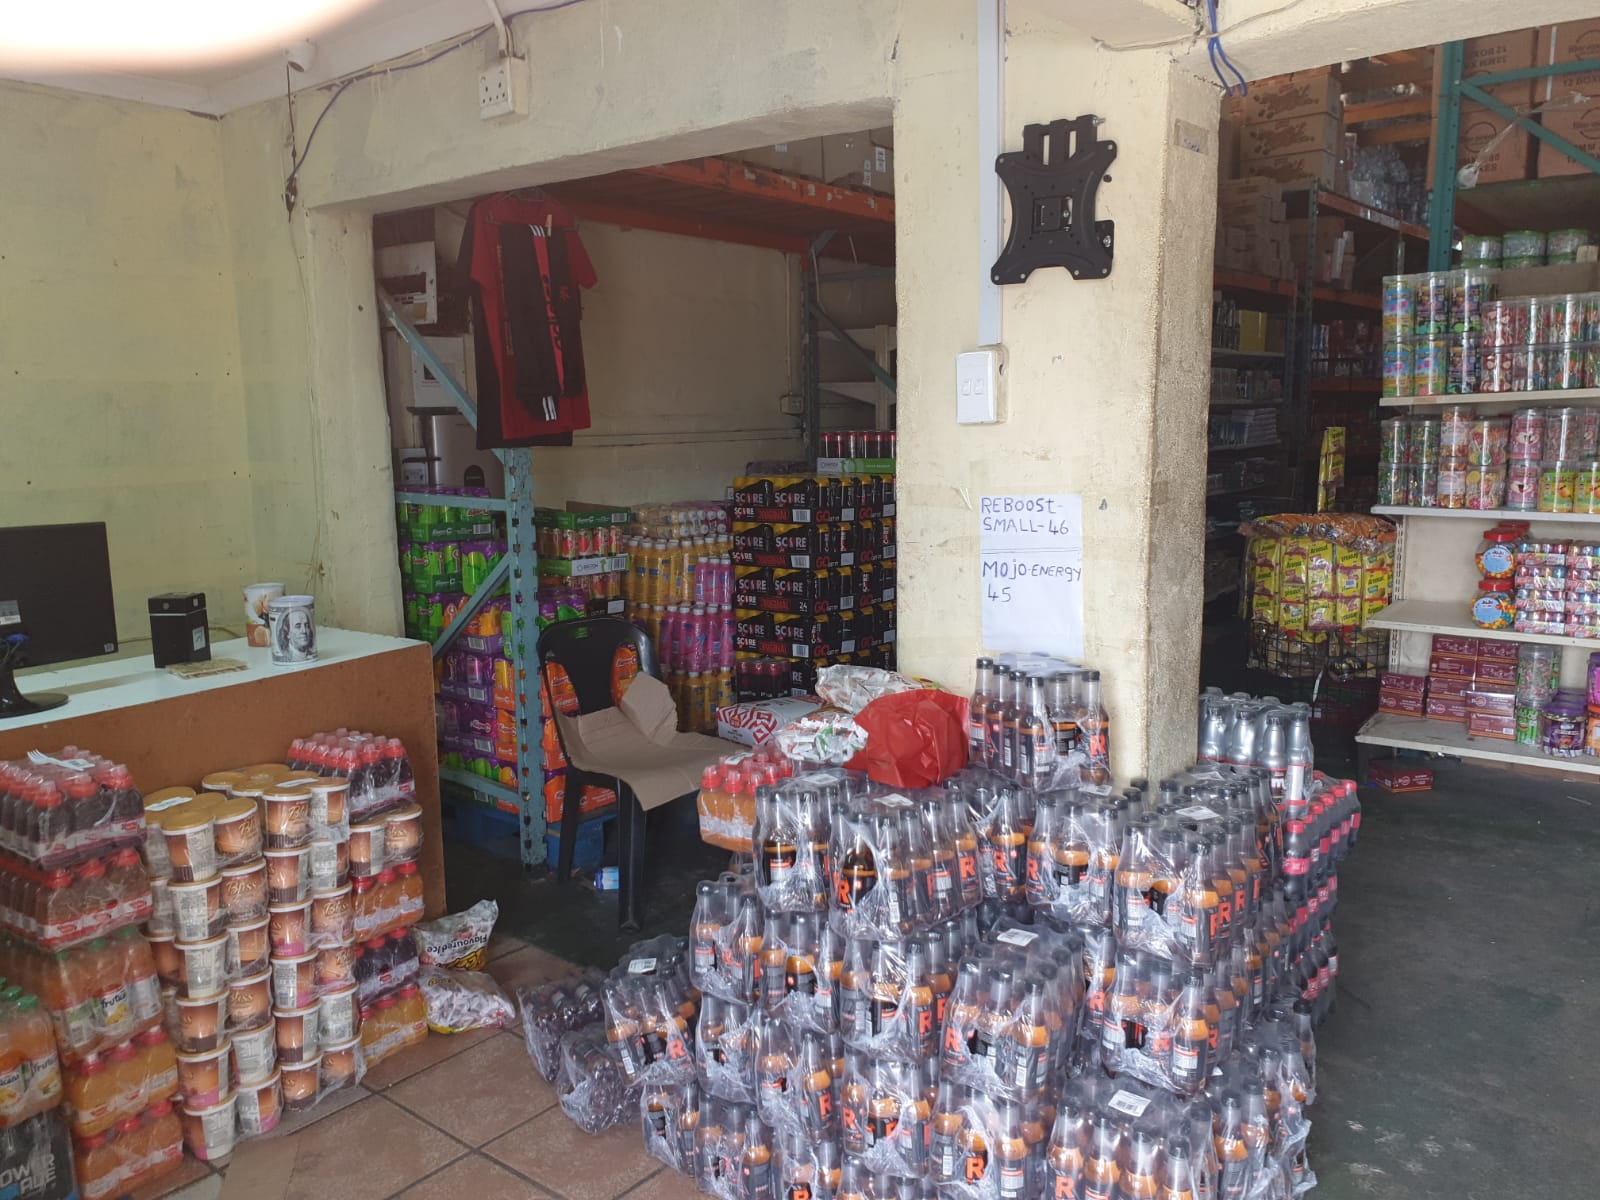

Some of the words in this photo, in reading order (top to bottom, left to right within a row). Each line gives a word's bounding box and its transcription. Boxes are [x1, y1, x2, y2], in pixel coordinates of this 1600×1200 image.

[987, 584, 1012, 602] 45
[960, 856, 978, 879] R
[1027, 857, 1040, 880] R
[838, 877, 851, 905] R
[1217, 902, 1232, 923] R
[919, 1010, 933, 1037] R
[819, 1093, 832, 1120] R
[966, 1156, 986, 1180] R
[1055, 1175, 1076, 1200] R
